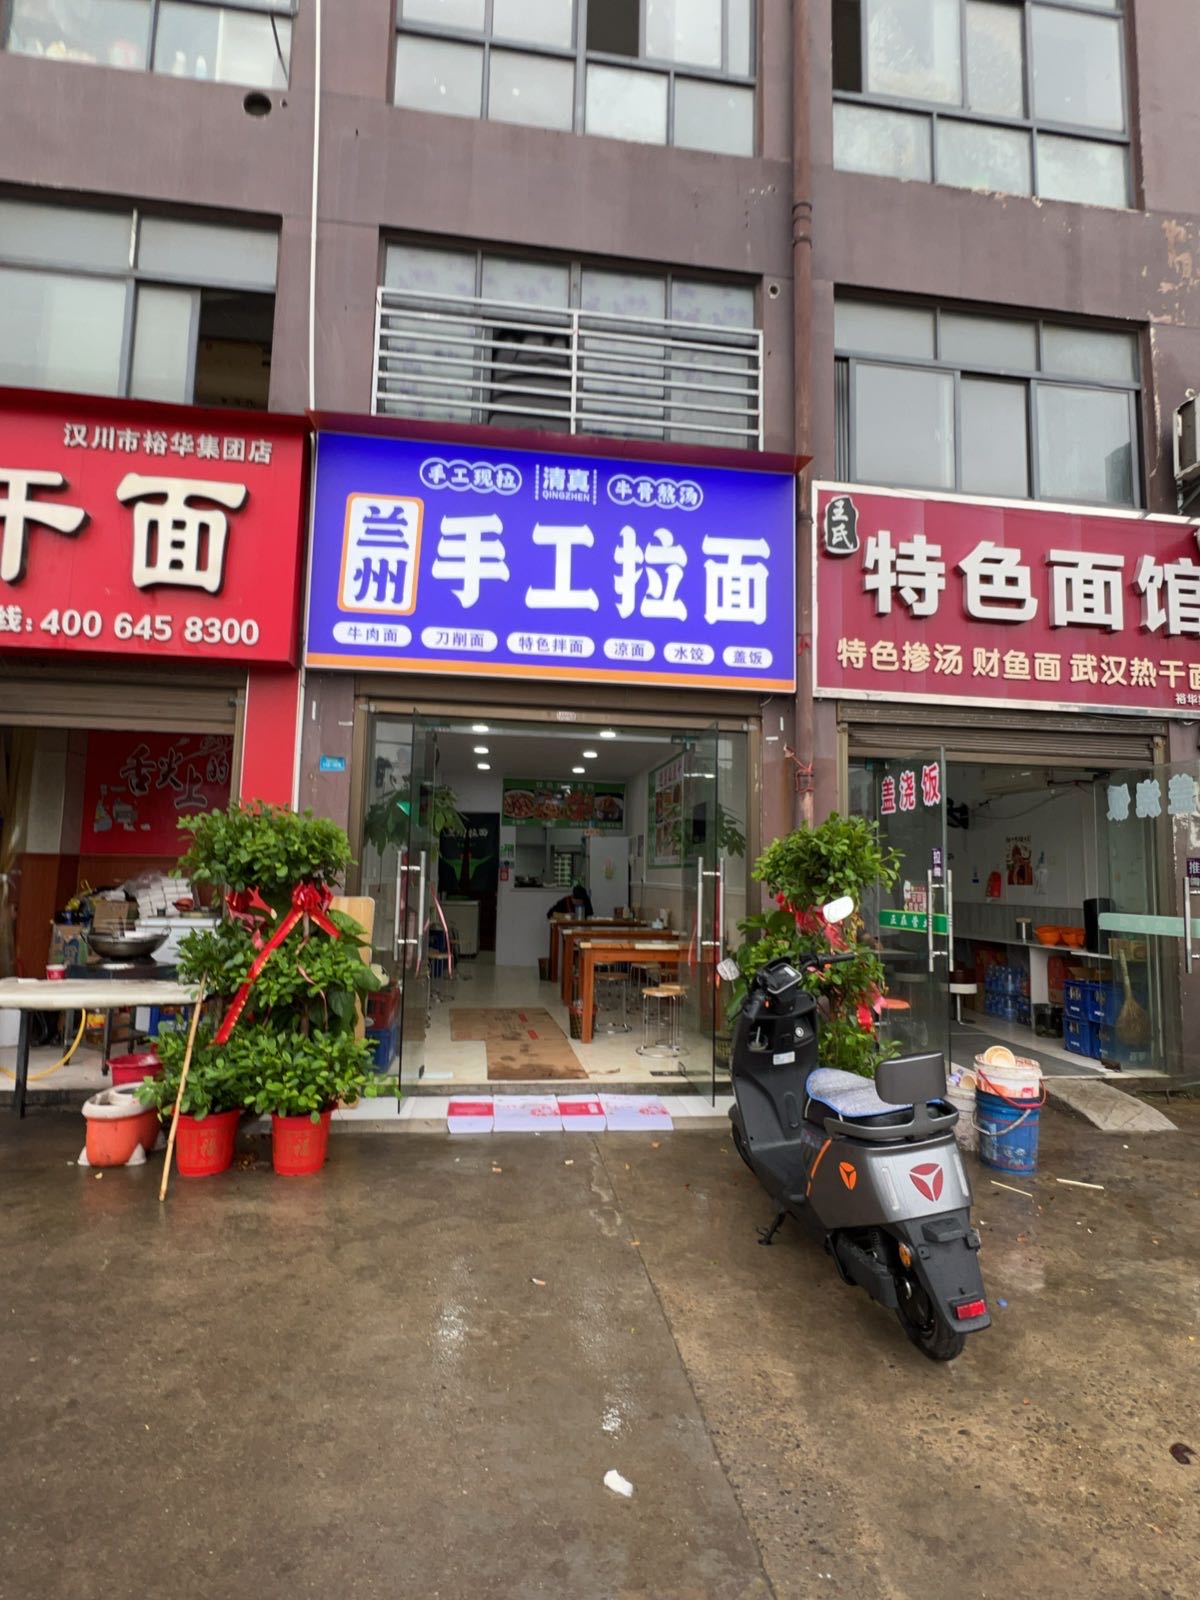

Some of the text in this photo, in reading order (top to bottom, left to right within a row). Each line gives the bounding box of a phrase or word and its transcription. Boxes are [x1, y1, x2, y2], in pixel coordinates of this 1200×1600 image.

[63, 423, 272, 464] 汉川市裕华集团店
[429, 463, 517, 489] 手工现拉
[543, 466, 591, 491] 清真
[615, 480, 698, 505] 牛骨熬汤
[542, 490, 590, 502] QINGZHEN
[831, 499, 854, 550] 王氏
[353, 505, 409, 604] 兰州
[431, 512, 771, 625] 手工拉面
[863, 530, 1200, 637] 特色面馆
[114, 615, 172, 640] 645
[184, 617, 260, 645] 8300
[347, 625, 763, 664] 牛肉面 刀削面 特色拌面 凉面 水饺 盖饭
[973, 647, 1061, 682] 财鱼面
[881, 762, 940, 814] 盖浇饭
